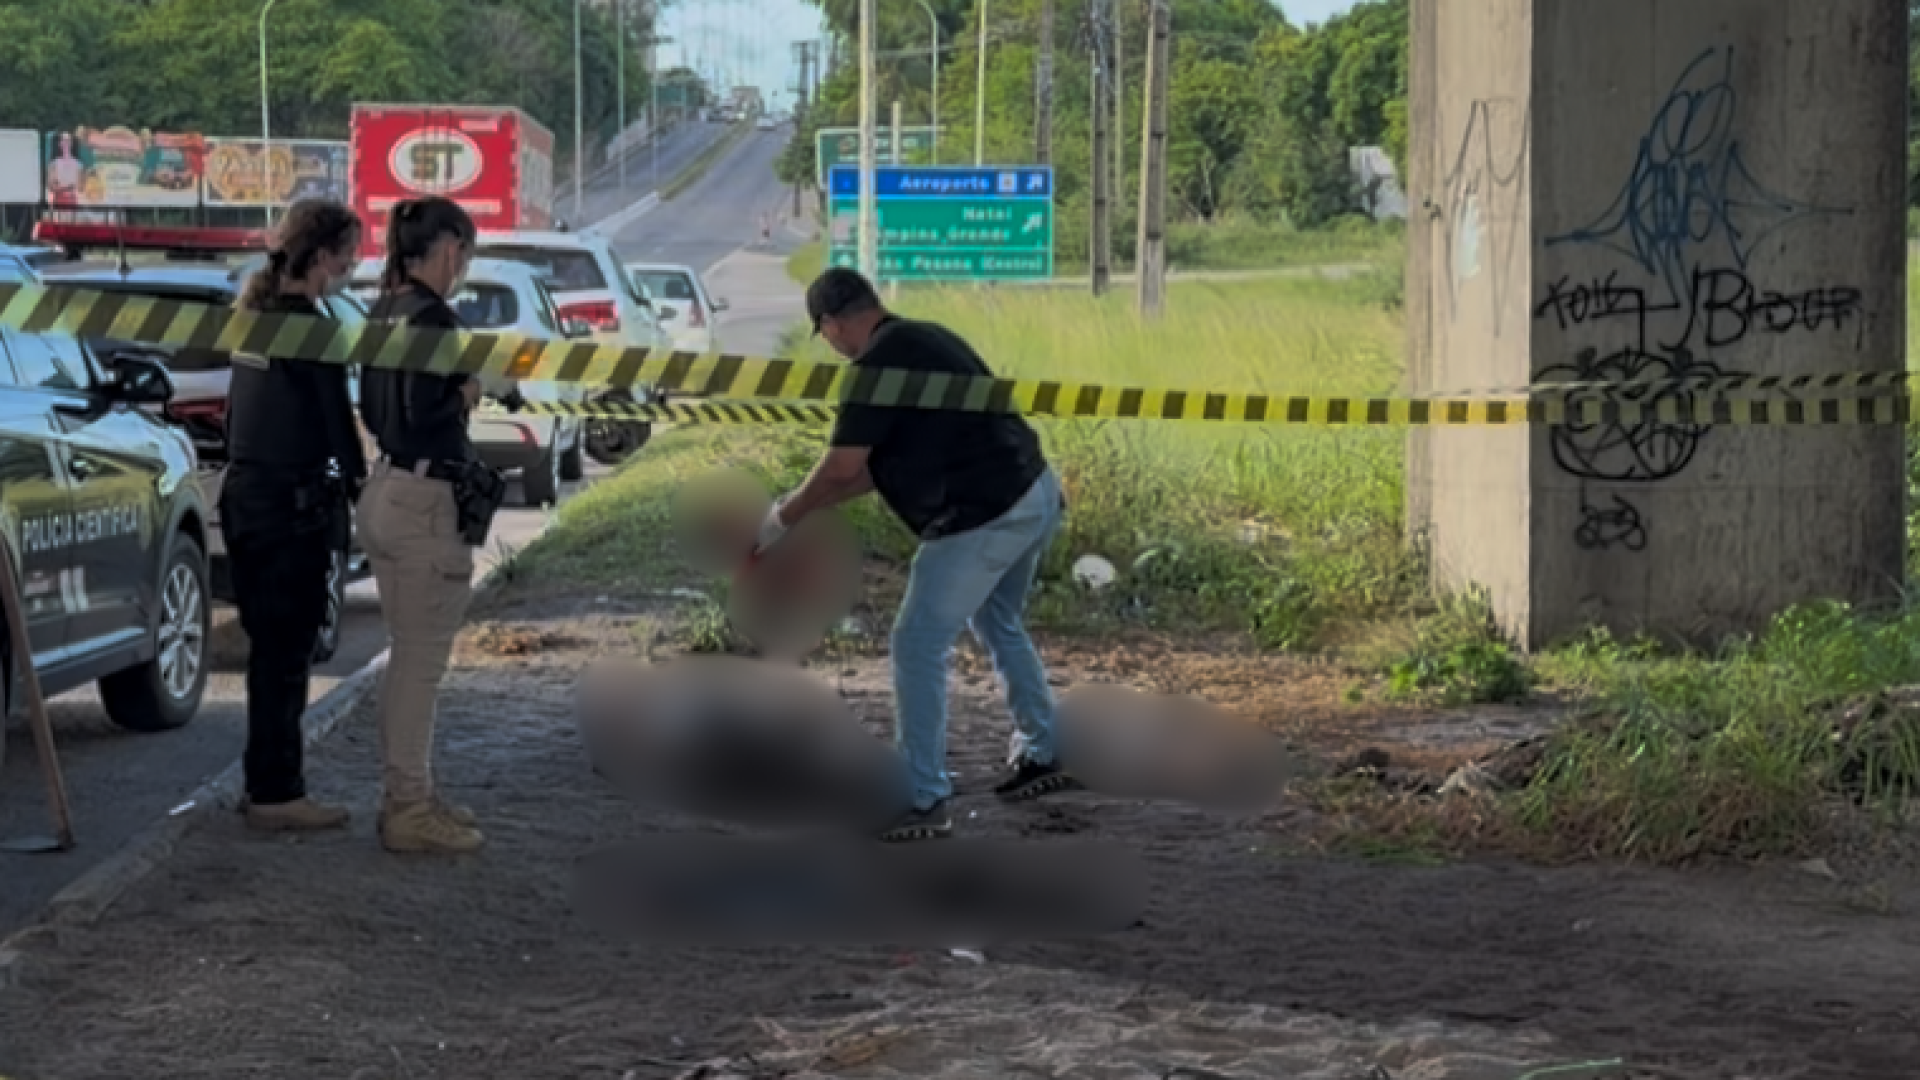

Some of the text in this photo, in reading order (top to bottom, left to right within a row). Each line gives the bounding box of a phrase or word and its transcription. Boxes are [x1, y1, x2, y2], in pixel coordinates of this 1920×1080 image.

[410, 143, 465, 180] ST
[898, 174, 990, 192] Aeroporto
[962, 206, 1013, 221] Natal
